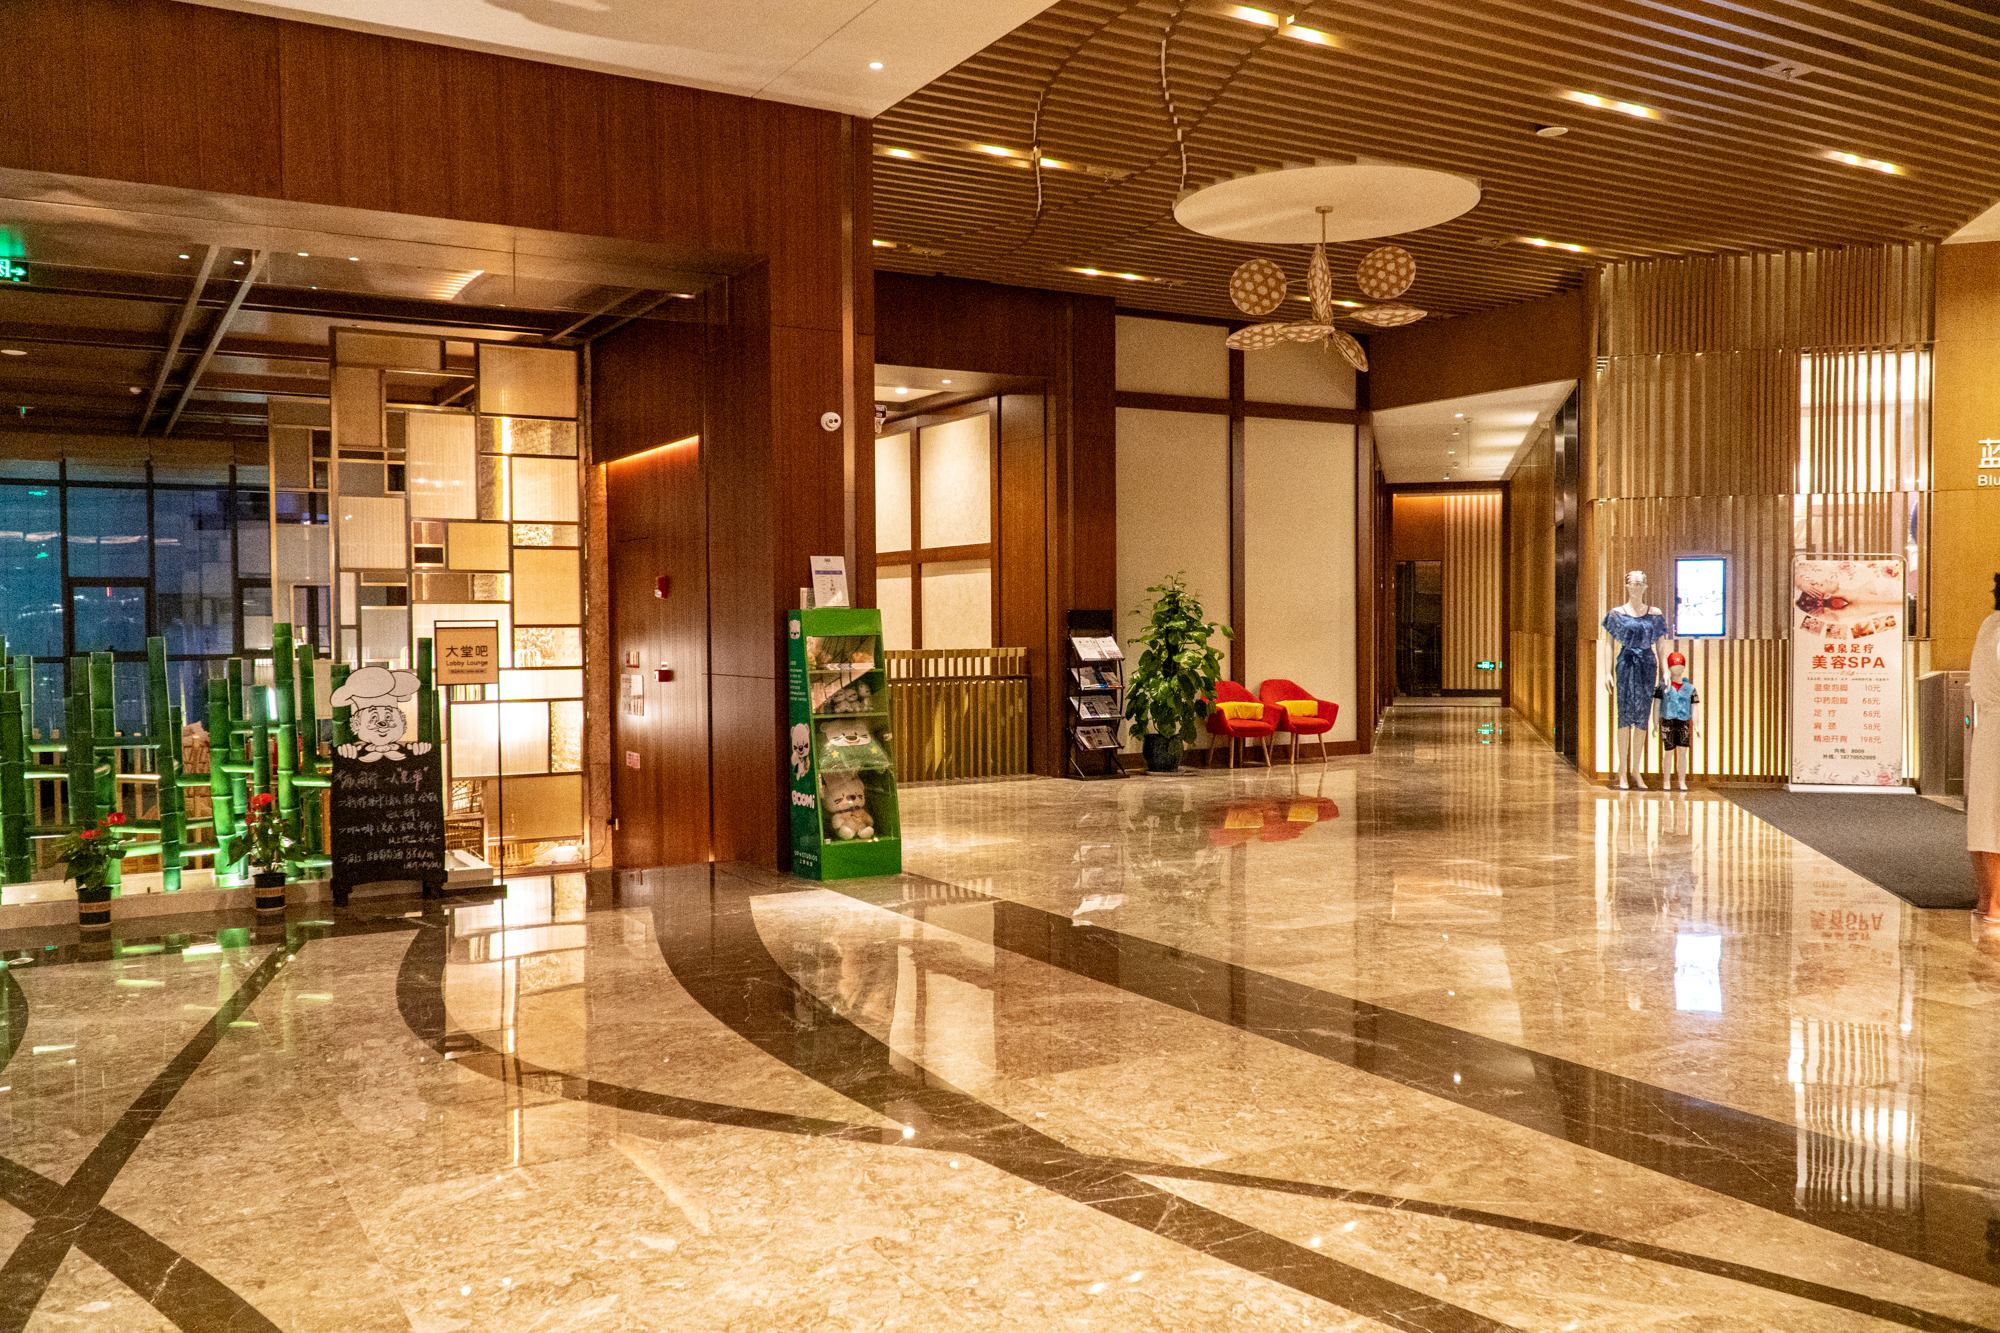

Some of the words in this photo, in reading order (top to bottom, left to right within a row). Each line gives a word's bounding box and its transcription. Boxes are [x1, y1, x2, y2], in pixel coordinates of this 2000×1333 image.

[446, 645, 488, 658] 大堂吧
[1812, 655, 1885, 669] 美容SPA
[1864, 684, 1882, 692] 10元
[1862, 697, 1880, 705] 68元
